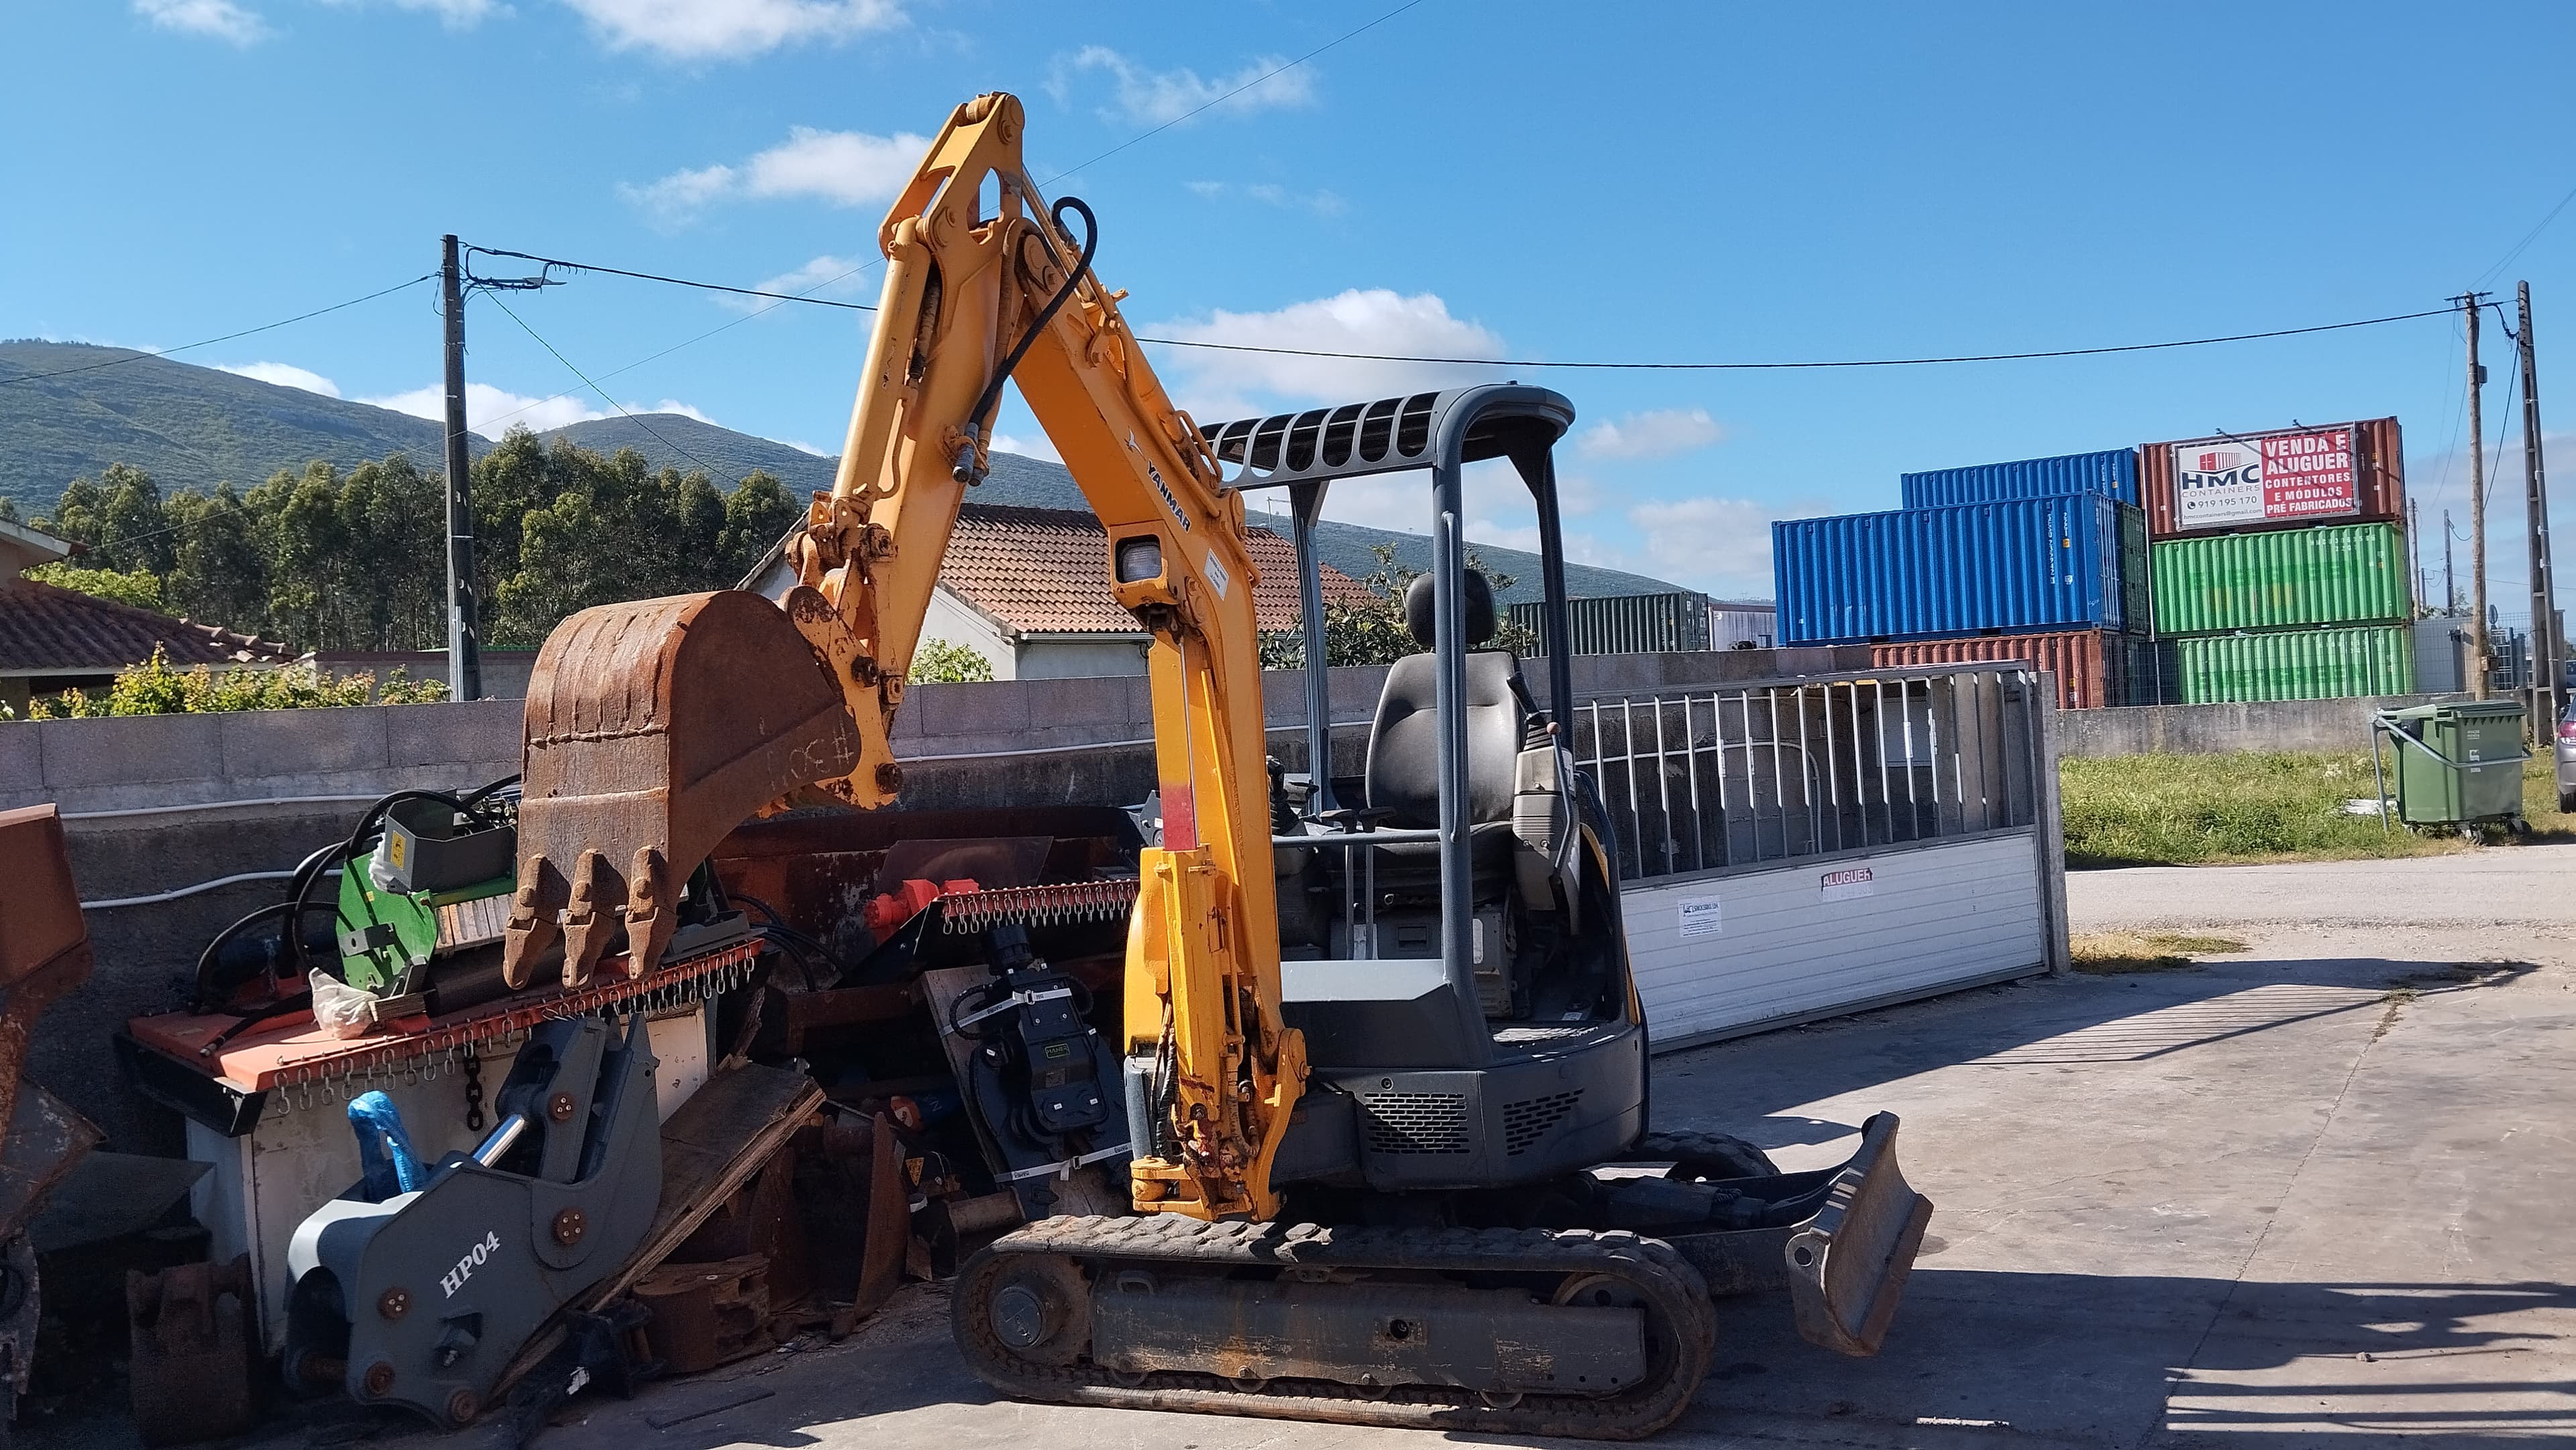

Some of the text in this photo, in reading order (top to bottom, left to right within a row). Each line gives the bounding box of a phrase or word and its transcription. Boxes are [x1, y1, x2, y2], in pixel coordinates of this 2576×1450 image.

[2265, 434, 2346, 457] VENDA E
[2266, 452, 2349, 475] ALUGUER
[2182, 464, 2260, 490] HMC
[2265, 472, 2350, 489] CONTENTORES
[1148, 460, 1191, 533] YANMAR
[2182, 484, 2260, 497] CONTAINERS
[2275, 486, 2343, 502] E MÓDULOS
[2198, 496, 2257, 509] 919 195 170
[2267, 497, 2352, 514] PRÉ FABRICADOS
[1823, 870, 1871, 886] ALUGUER
[439, 1231, 500, 1298] HP04
